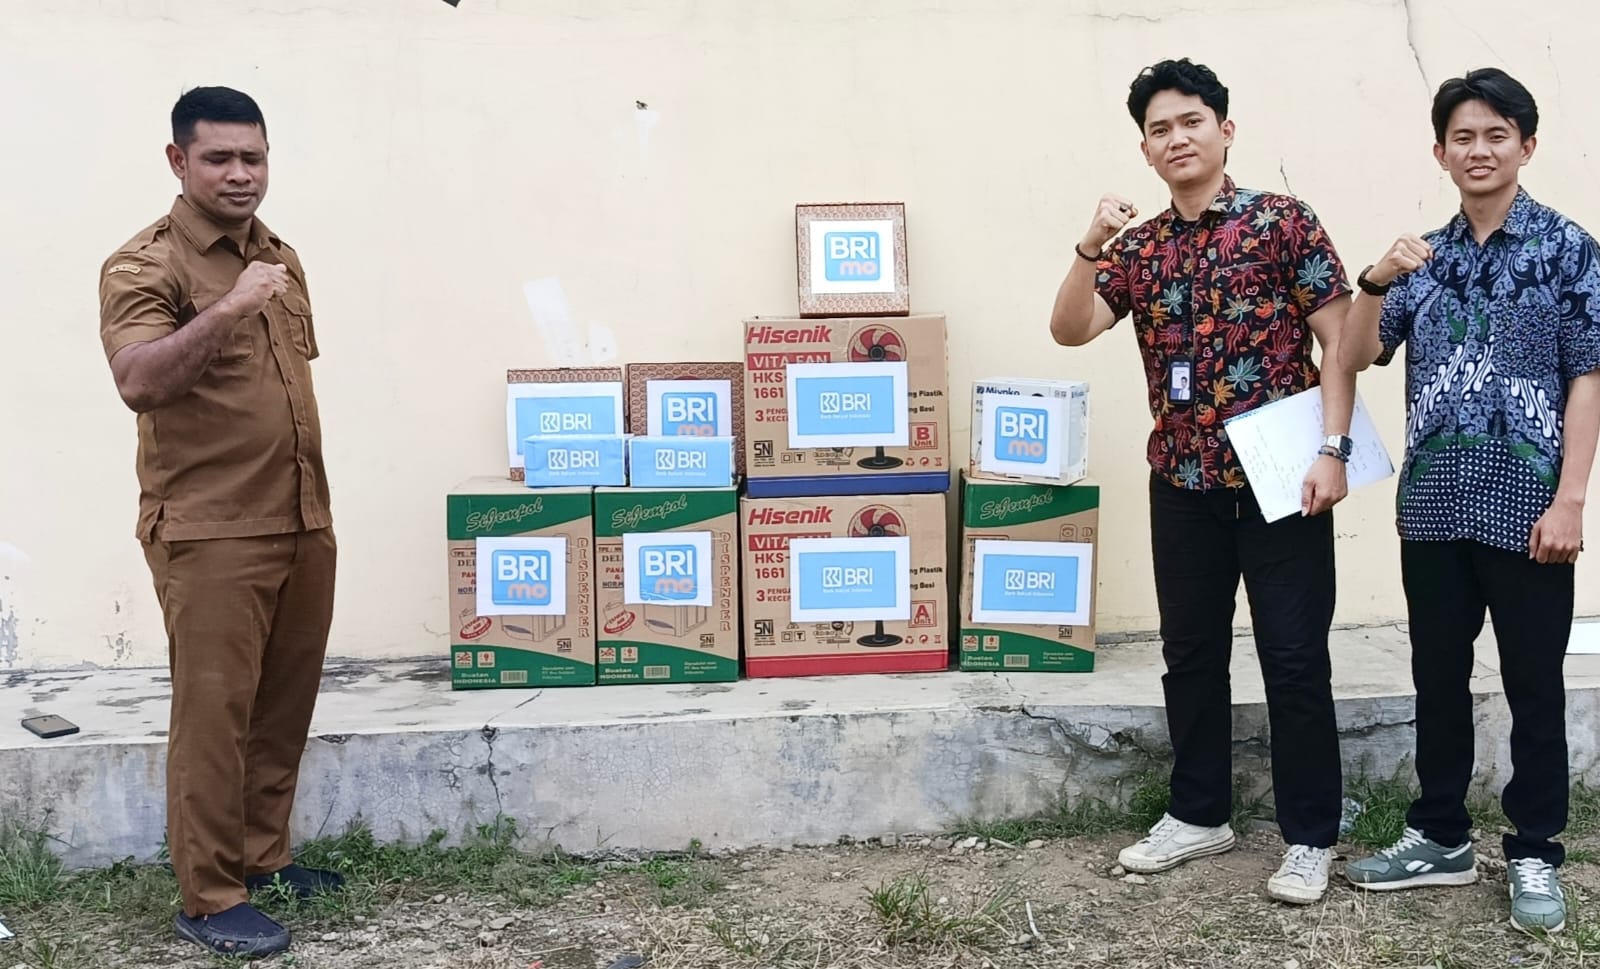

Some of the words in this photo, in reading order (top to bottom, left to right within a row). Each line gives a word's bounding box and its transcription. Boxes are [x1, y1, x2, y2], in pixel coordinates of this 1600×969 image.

[831, 236, 876, 260] BRI
[840, 261, 877, 276] mo
[747, 325, 832, 344] Hisenik
[753, 356, 787, 368] VITA
[754, 387, 784, 398] 1661
[668, 397, 714, 422] BRI
[842, 393, 871, 411] BRI
[563, 413, 592, 430] BRI
[755, 410, 765, 422] 3
[916, 427, 930, 440] B
[1000, 412, 1046, 440] BRI
[1008, 440, 1044, 457] mo
[570, 451, 599, 468] BRI
[678, 451, 706, 469] BRI
[748, 506, 832, 526] Hisenik
[754, 537, 789, 549] VITA
[497, 555, 548, 580] BRI
[645, 550, 694, 576] BRI
[755, 568, 785, 579] 1661
[844, 568, 872, 585] BRI
[1027, 572, 1055, 589] BRI
[508, 583, 548, 599] mo
[655, 579, 695, 594] mo
[756, 590, 765, 602] 3
[914, 605, 930, 618] A
